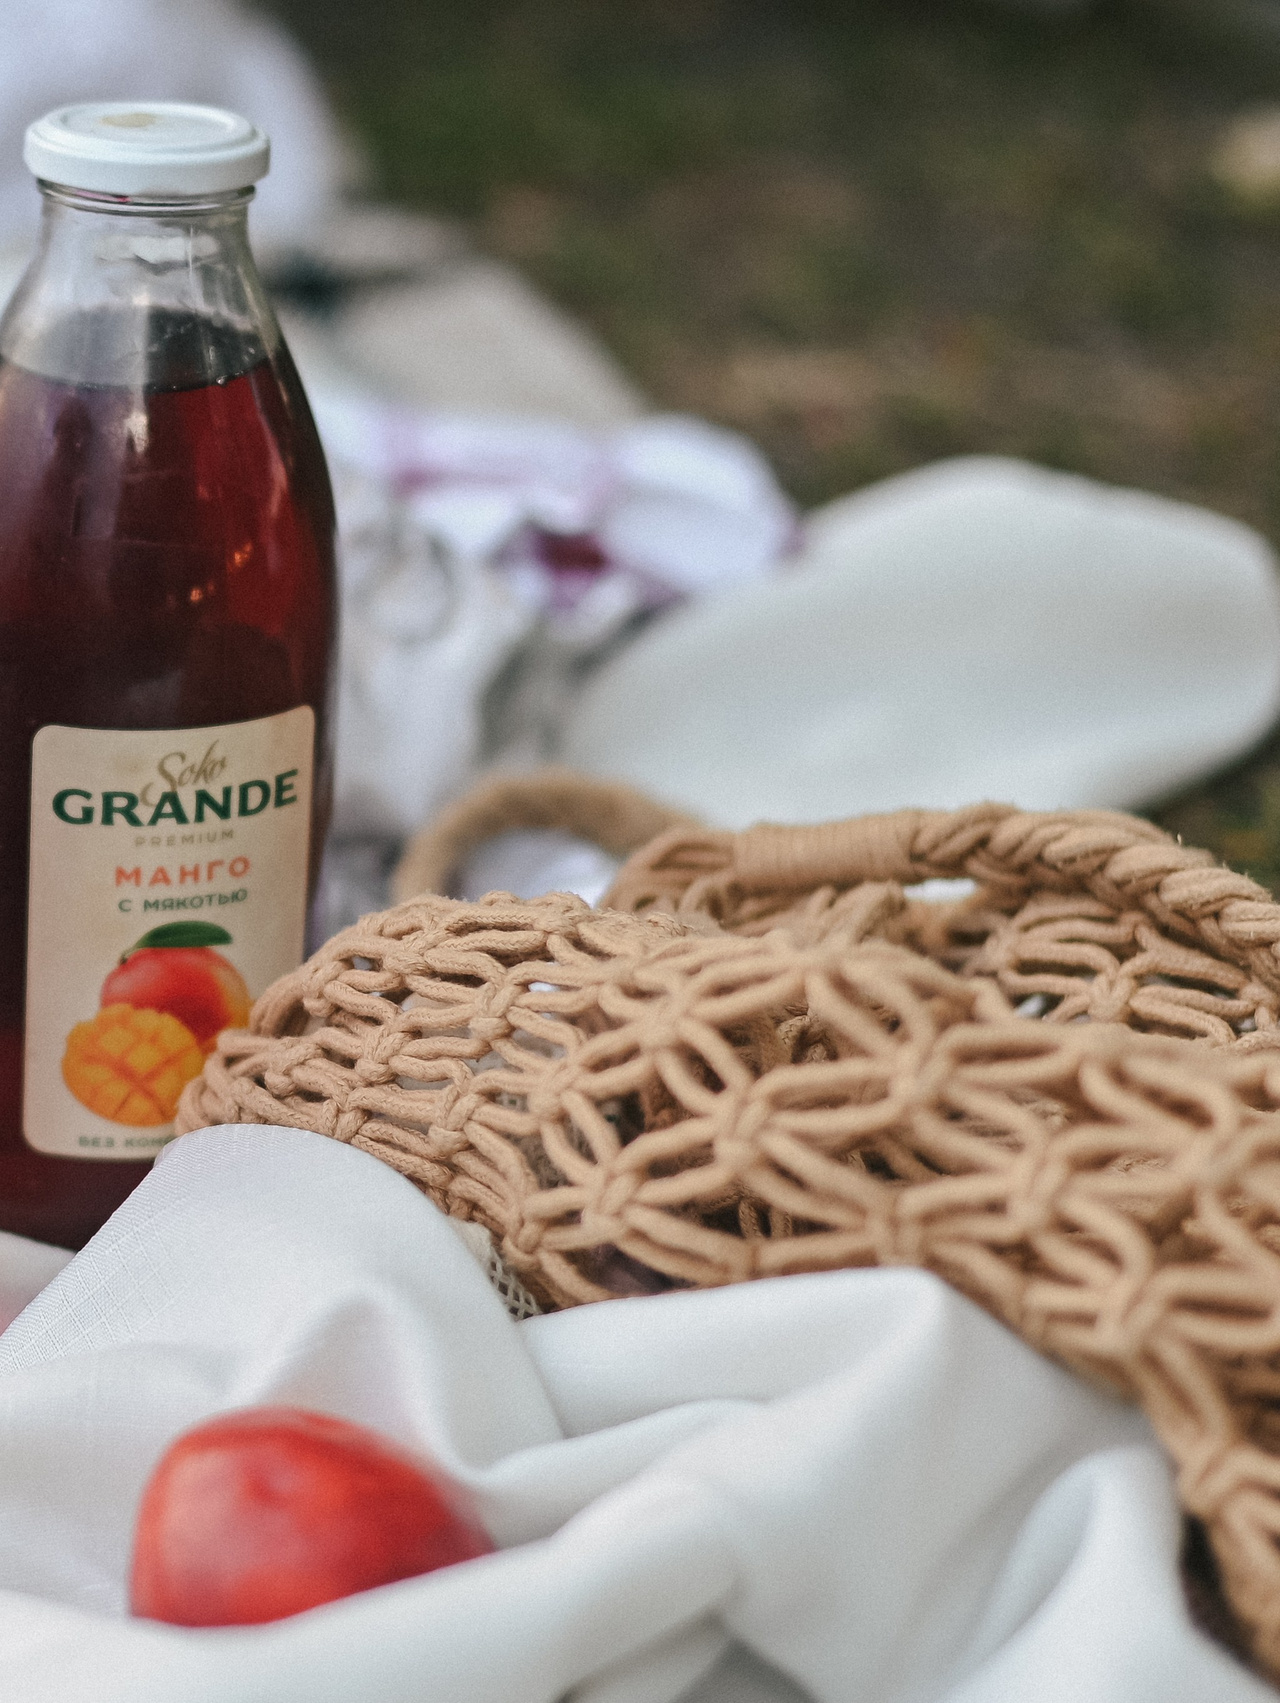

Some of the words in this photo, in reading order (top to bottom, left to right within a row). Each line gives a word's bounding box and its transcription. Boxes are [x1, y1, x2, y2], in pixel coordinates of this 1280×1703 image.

[52, 768, 299, 827] GRANDE
[134, 828, 235, 848] PREMIUM
[114, 855, 251, 888] МАНГО
[117, 898, 132, 913] С
[143, 888, 248, 912] МЯКОТЬЮ
